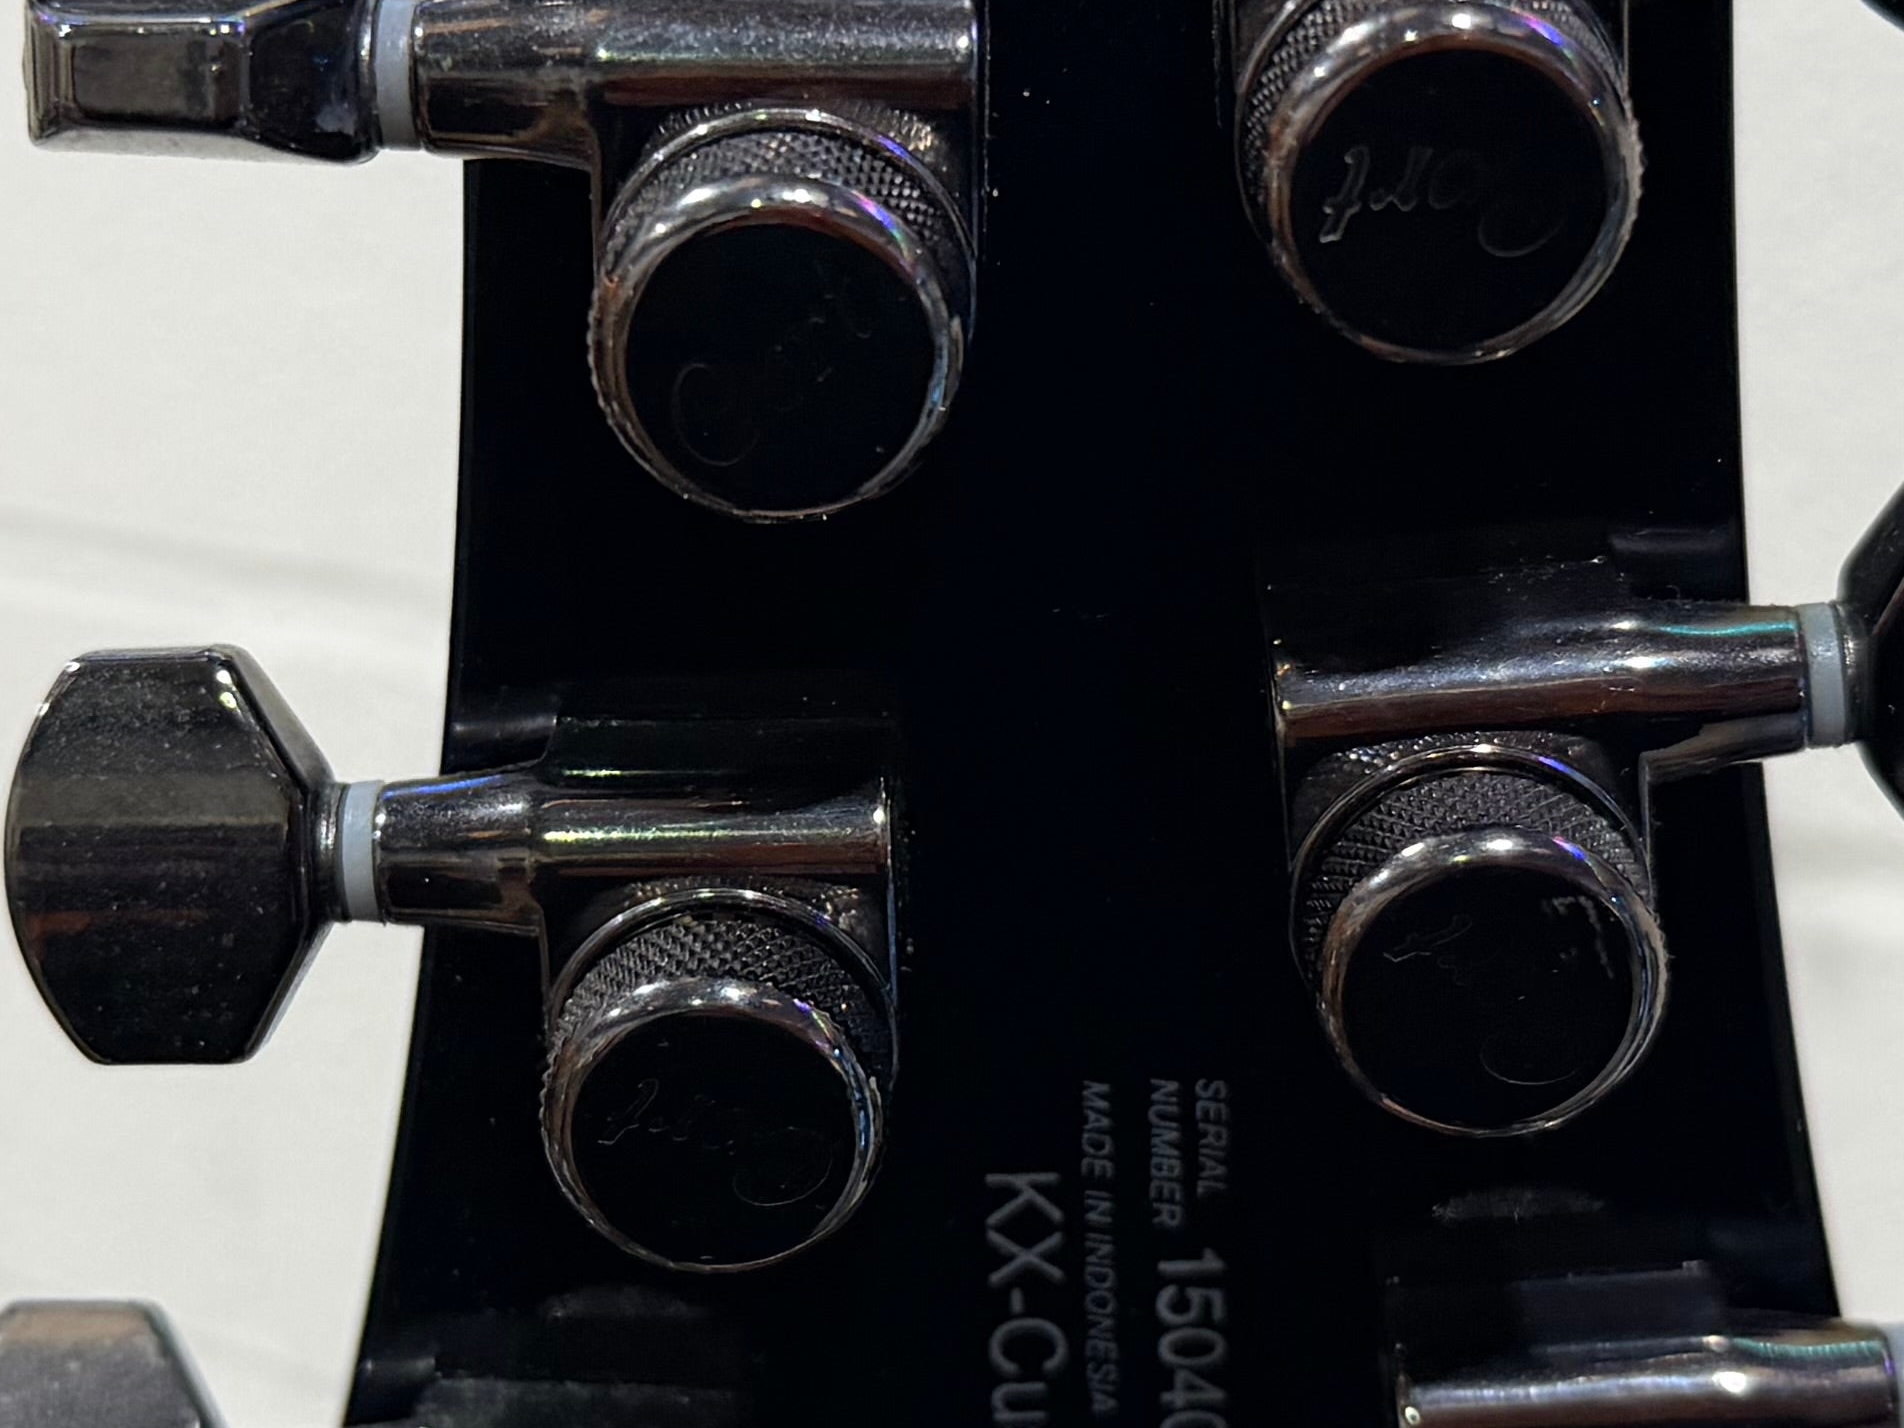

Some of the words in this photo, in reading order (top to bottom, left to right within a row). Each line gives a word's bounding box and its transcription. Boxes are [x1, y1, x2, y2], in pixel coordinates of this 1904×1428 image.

[1080, 1079, 1114, 1180] MADE
[1147, 1077, 1183, 1230] NUMBER
[1195, 1077, 1229, 1198] SERIAL
[1082, 1189, 1115, 1223] IN
[1083, 1232, 1121, 1419] INDONESIA
